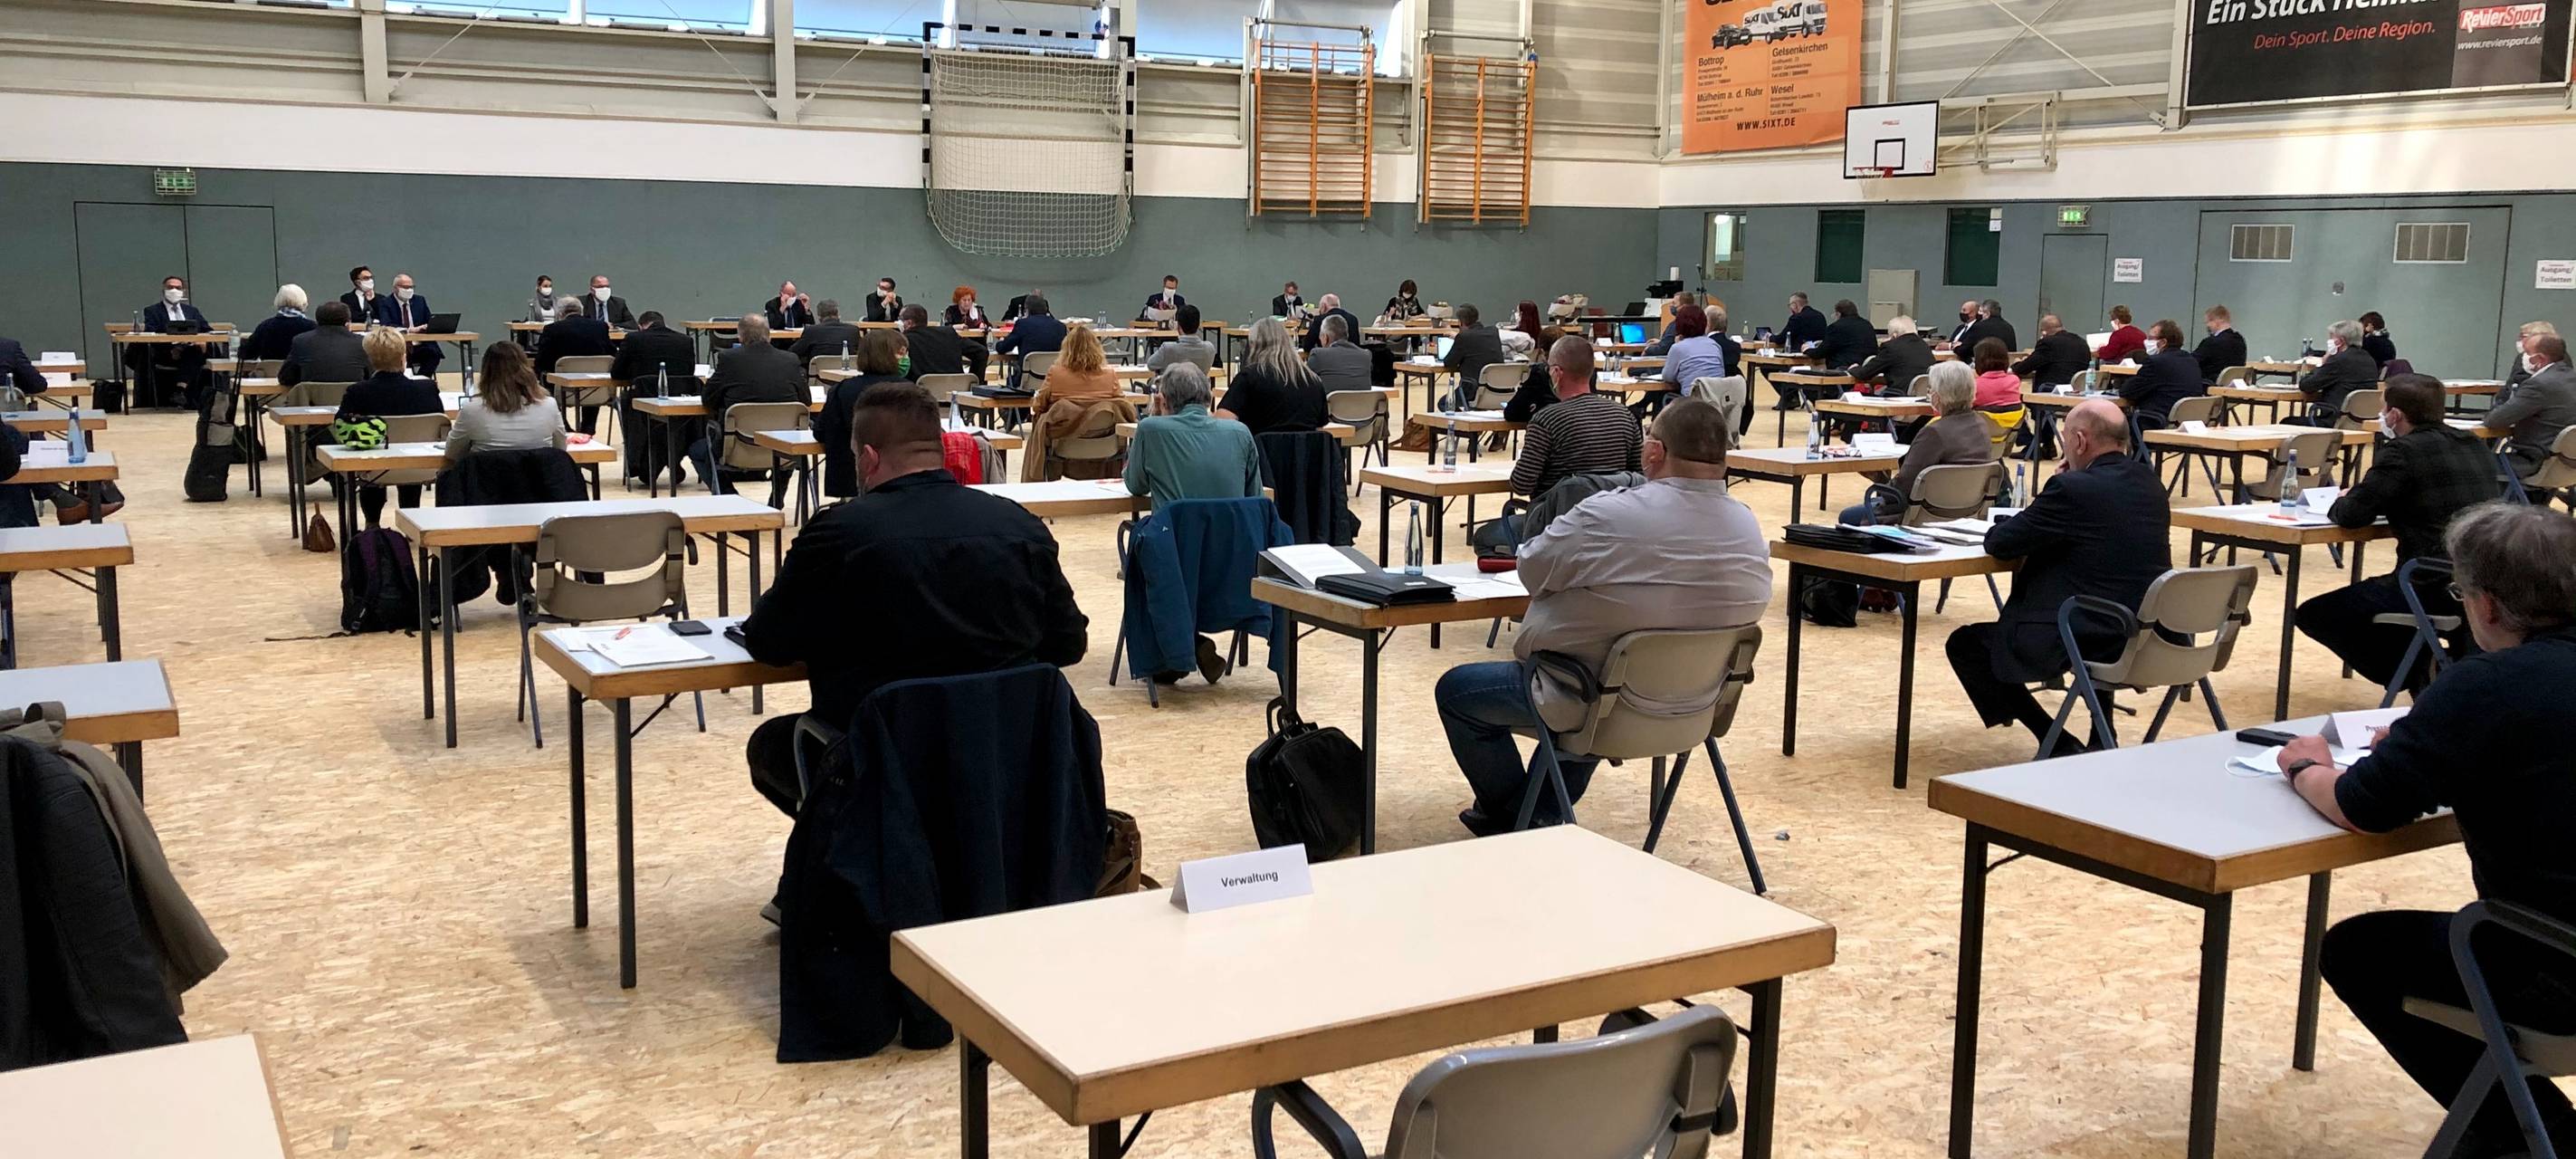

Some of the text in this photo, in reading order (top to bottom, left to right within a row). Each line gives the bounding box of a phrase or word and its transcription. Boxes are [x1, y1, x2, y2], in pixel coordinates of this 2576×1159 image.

[2207, 0, 2247, 24] Ein
[2462, 6, 2543, 33] RevierSport
[2254, 20, 2436, 49] Dein Sport. Deine Region.
[1772, 43, 1828, 57] Gelsenkirchen
[2457, 35, 2543, 50] www.reviersport.de
[1698, 56, 1724, 67] Bottrop
[1697, 91, 1726, 102] Mülheim
[1745, 87, 1763, 97] Ruhr
[1770, 83, 1794, 94] Wesel
[1737, 117, 1796, 130] WWW.SIXT.DE
[1221, 871, 1278, 887] Verwaltung
